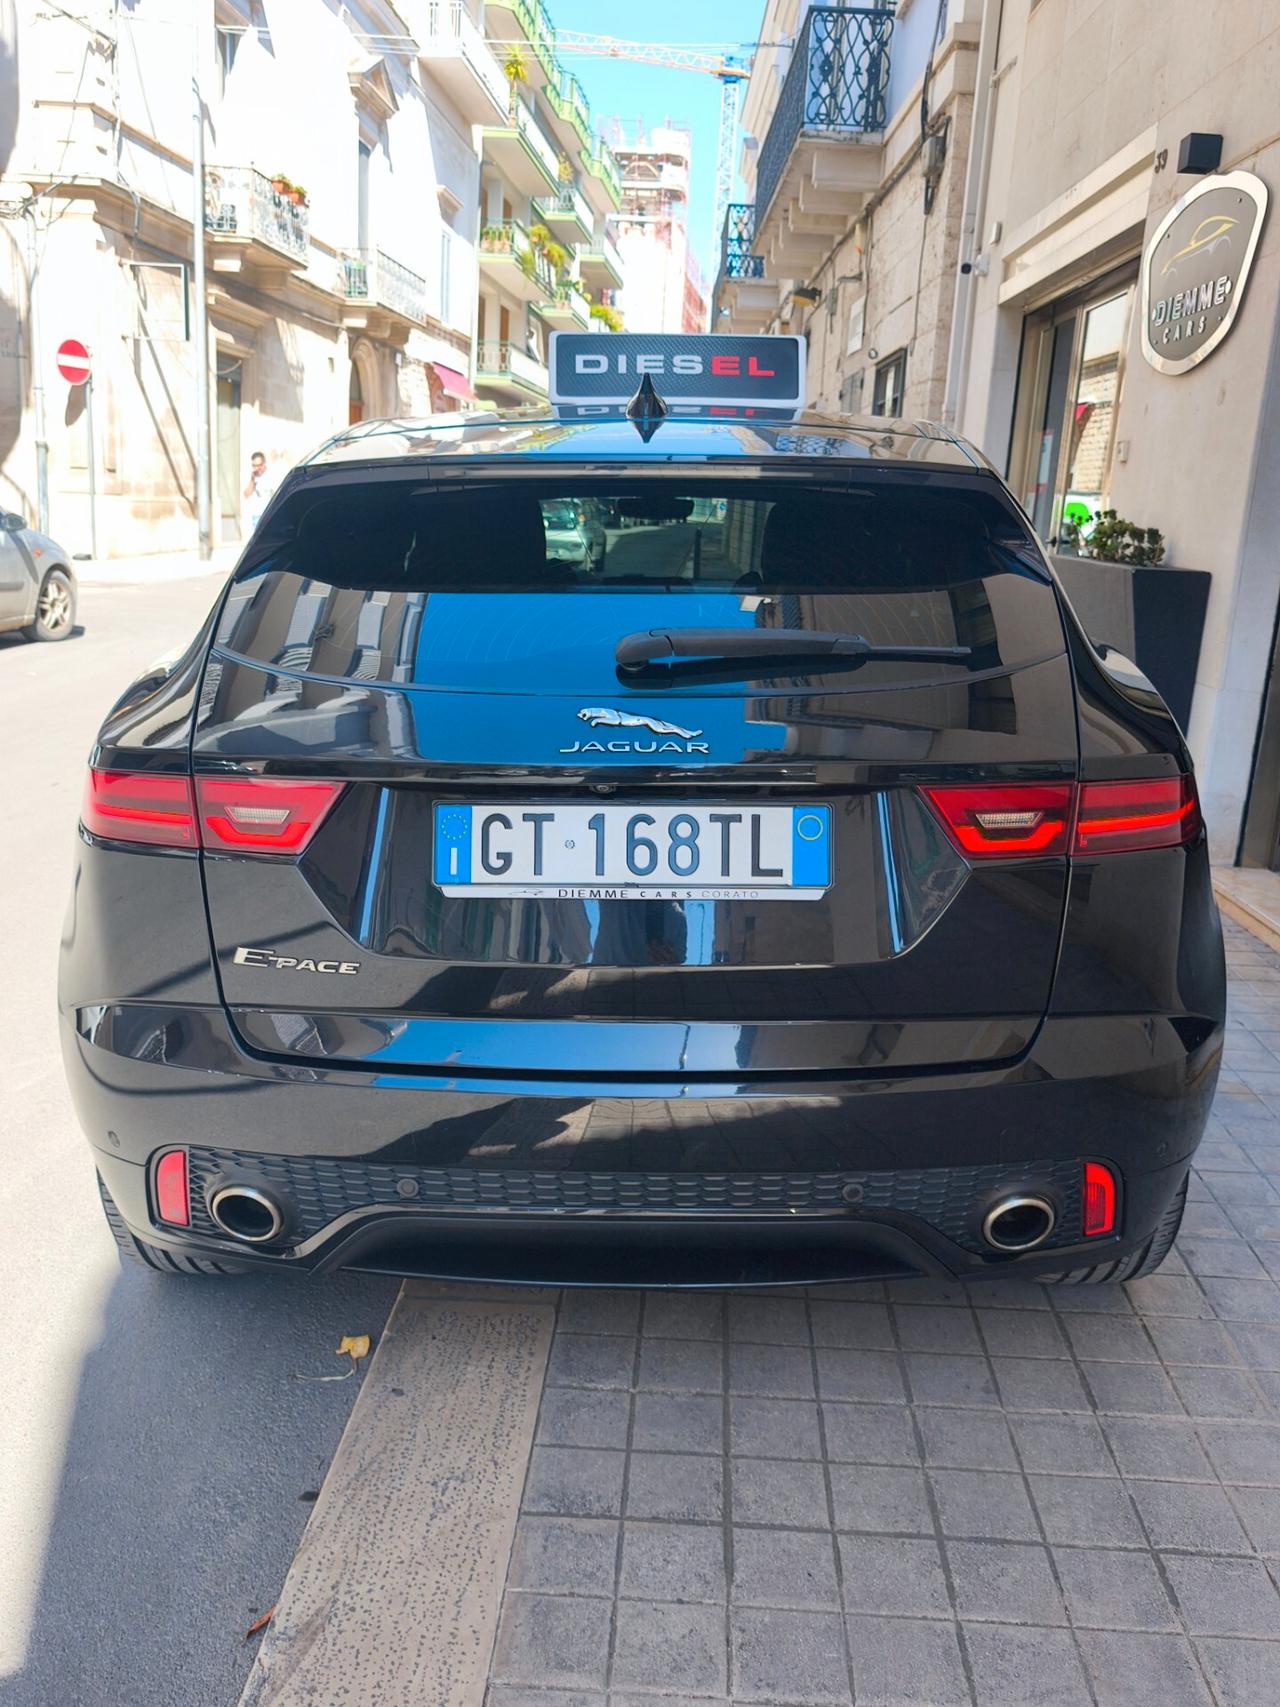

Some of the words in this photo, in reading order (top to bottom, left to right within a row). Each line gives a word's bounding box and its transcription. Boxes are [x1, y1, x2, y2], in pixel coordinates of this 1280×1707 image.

[1154, 275, 1229, 327] DIEMME
[1162, 316, 1207, 345] CARS
[575, 354, 775, 377] DIESEL
[559, 740, 710, 754] JAGUAR
[558, 889, 629, 899] DIEMME
[639, 890, 693, 899] CARS
[701, 890, 759, 899] CORATO
